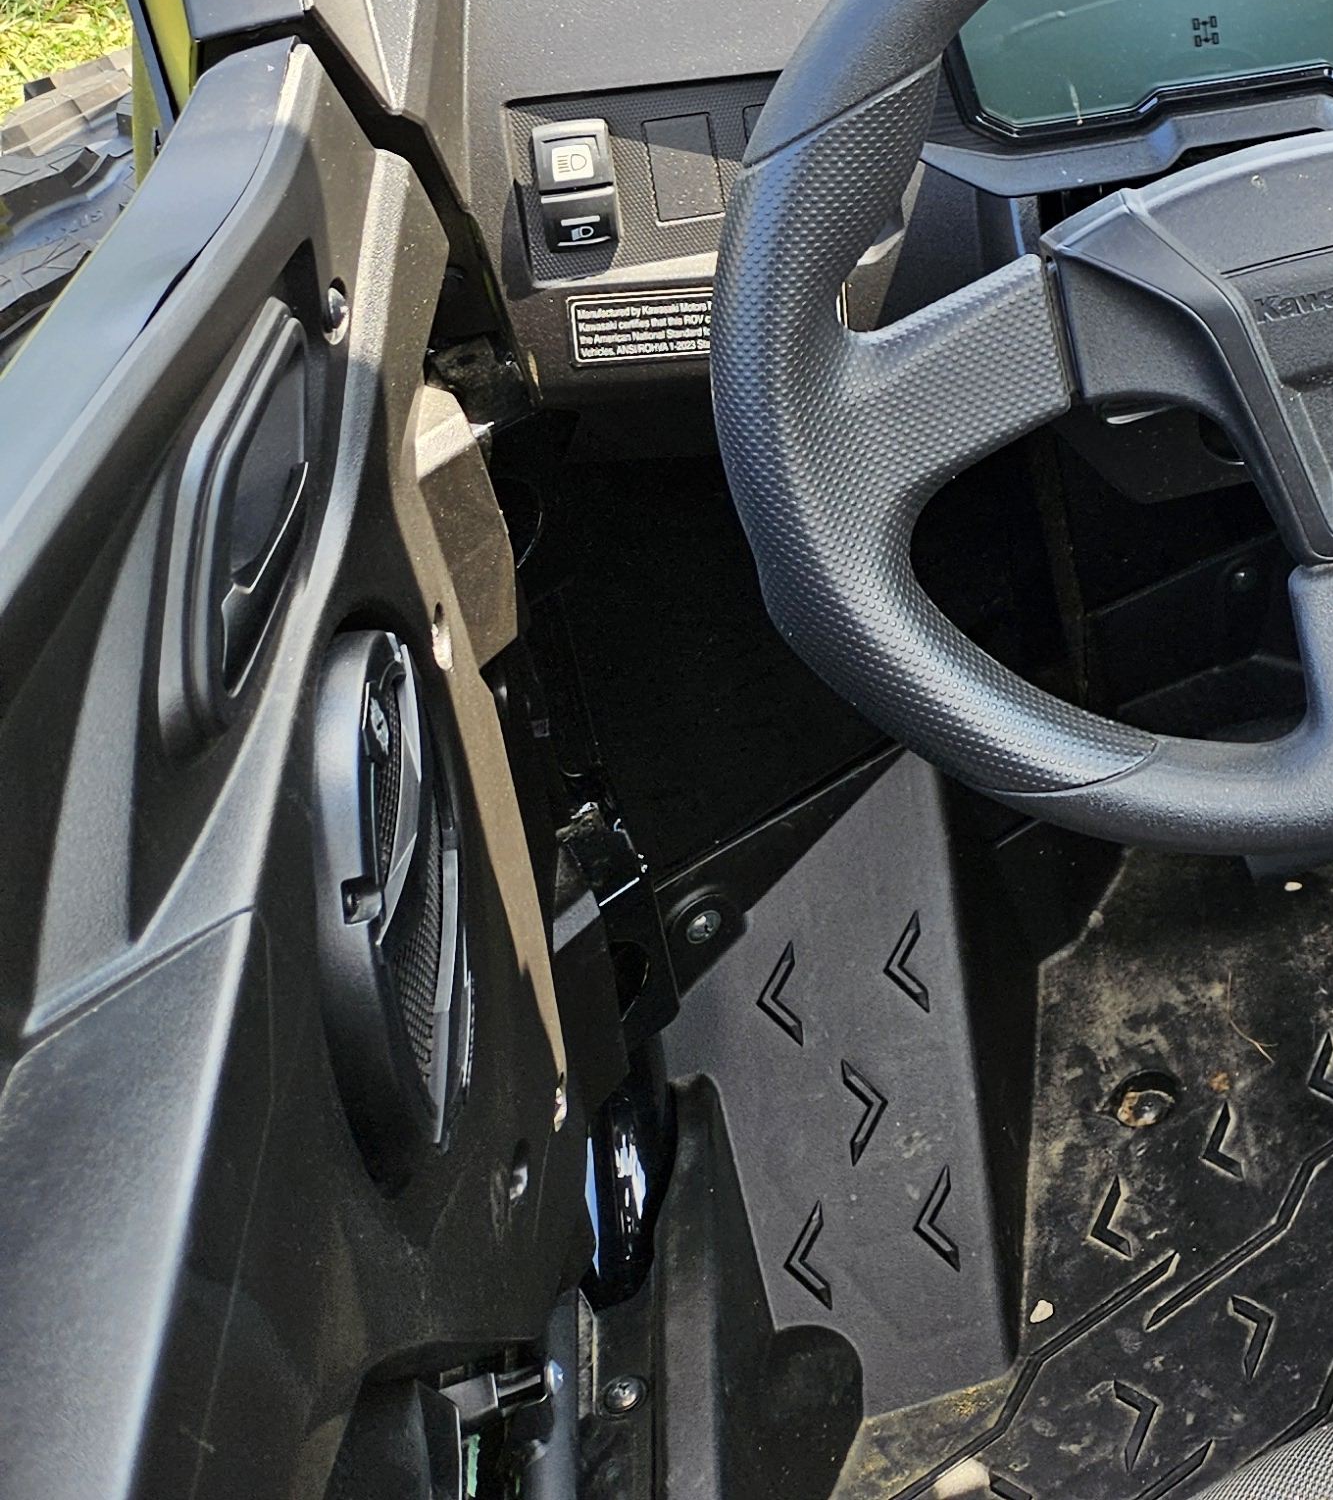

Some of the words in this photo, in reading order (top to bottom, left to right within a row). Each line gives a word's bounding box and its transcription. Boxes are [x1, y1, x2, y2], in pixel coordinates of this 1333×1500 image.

[642, 304, 679, 315] Kawasaki
[578, 321, 617, 332] Kawasaki
[684, 315, 704, 325] ROV
